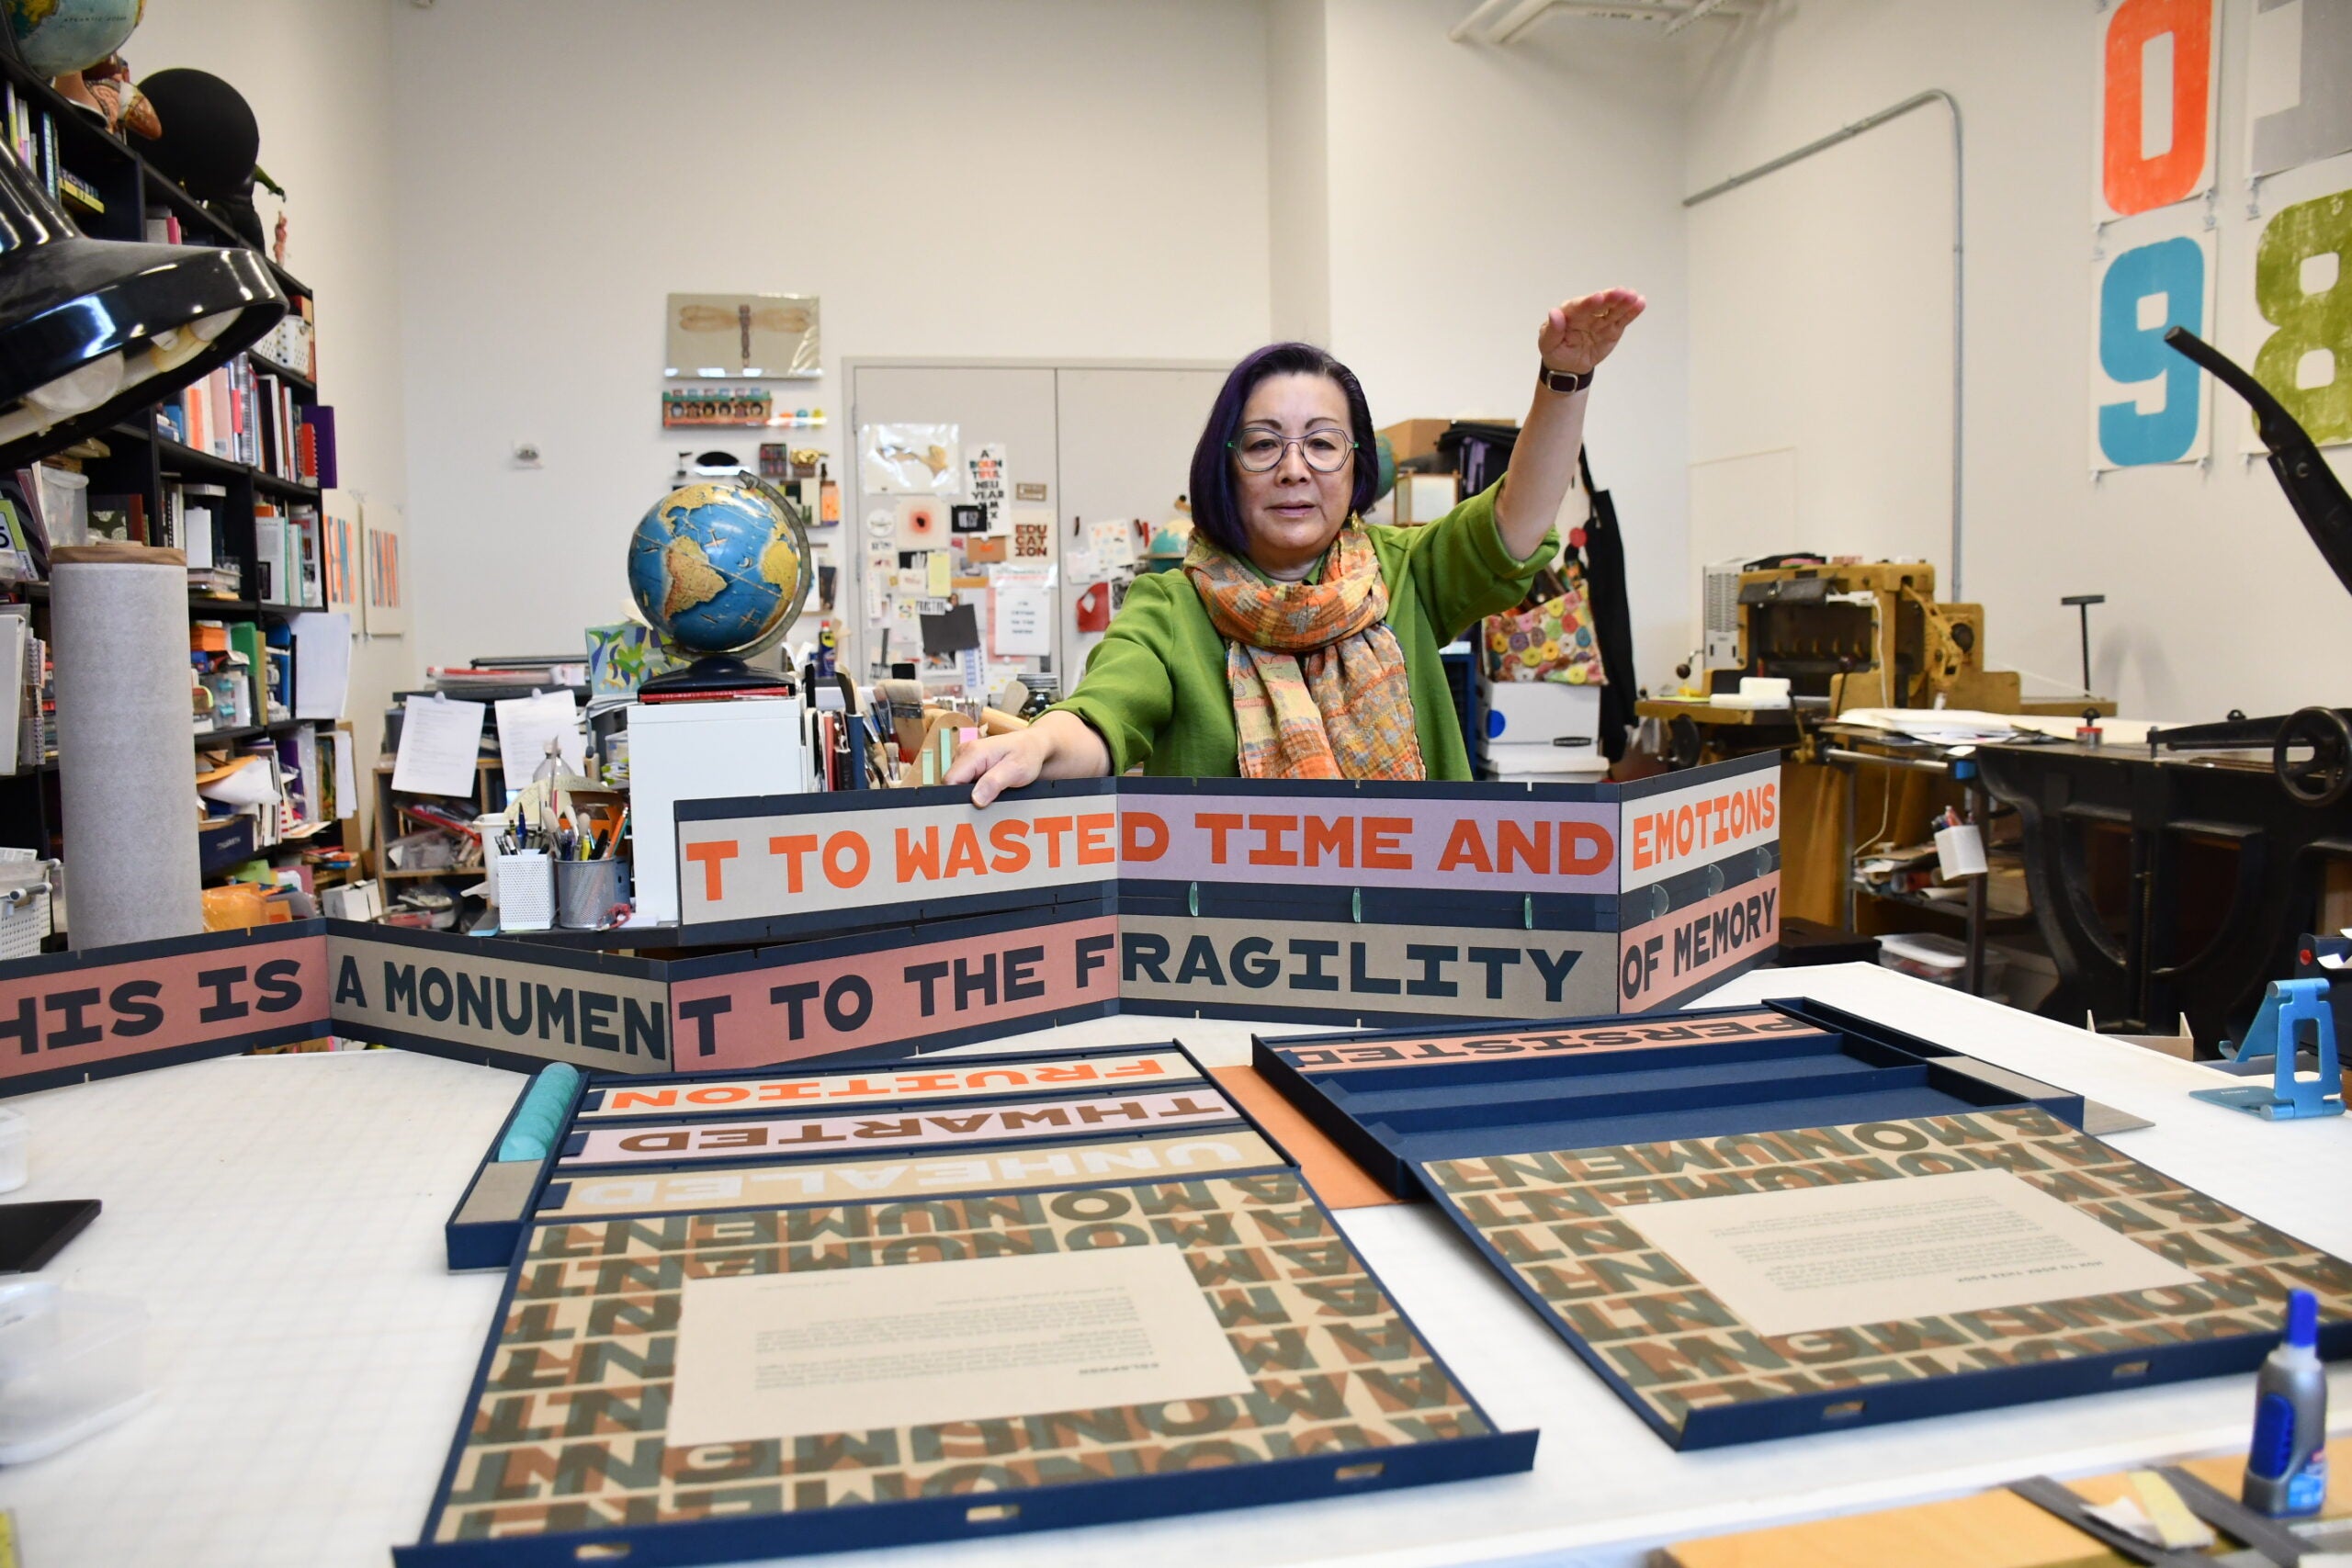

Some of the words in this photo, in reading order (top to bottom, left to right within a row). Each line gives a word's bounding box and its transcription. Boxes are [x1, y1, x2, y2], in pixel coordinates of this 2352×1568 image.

[2098, 235, 2205, 467] 9
[2251, 189, 2352, 443] 8
[971, 491, 1004, 500] YEAR
[1015, 524, 1047, 535] EDU
[1015, 536, 1047, 546] CAT
[1015, 547, 1047, 557] ION
[768, 829, 871, 894] TO
[895, 811, 1170, 884] WASTED
[1194, 812, 1414, 871] TIME
[1438, 819, 1615, 876] AND
[1632, 782, 1776, 872] EMOTIONS
[198, 958, 303, 1024] IS
[334, 954, 368, 1009] A
[769, 974, 874, 1041] TO
[903, 944, 1045, 1018] THE
[1075, 931, 1584, 1003] FRAGILITY
[1622, 936, 1663, 1000] OF
[1673, 887, 1777, 977] MEMORY
[611, 1058, 1165, 1110] FRUITION
[617, 1097, 1227, 1153] THWARTED
[576, 1140, 1243, 1208] UNHEALED
